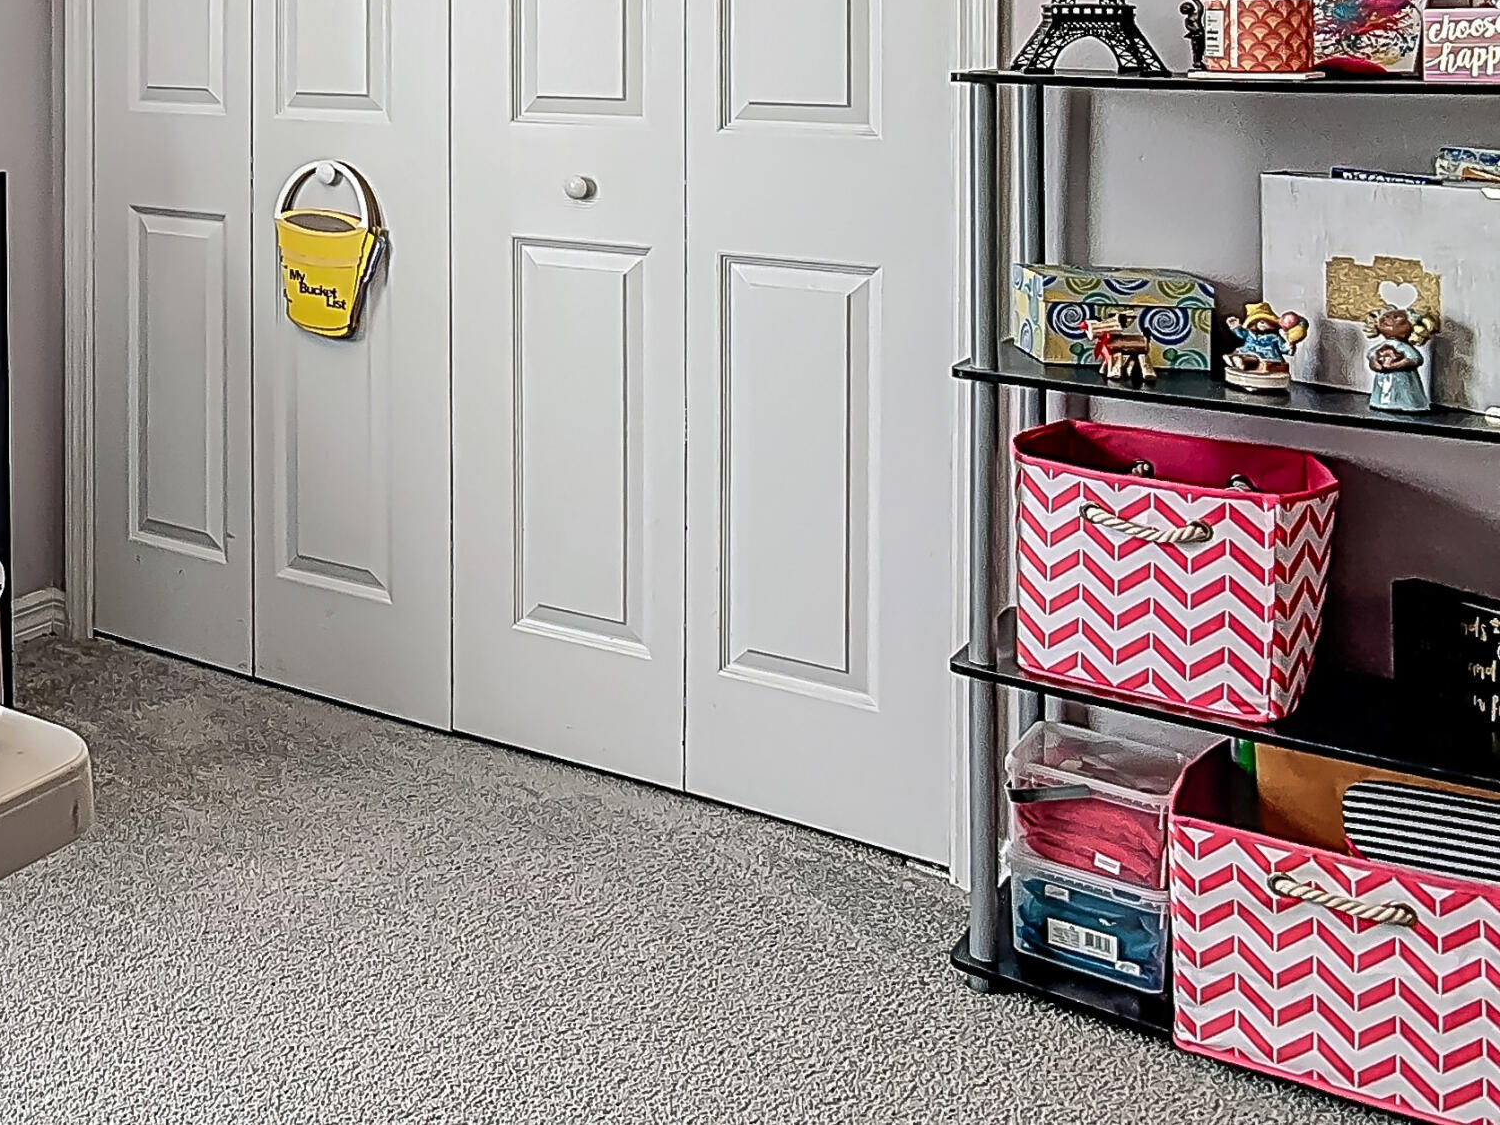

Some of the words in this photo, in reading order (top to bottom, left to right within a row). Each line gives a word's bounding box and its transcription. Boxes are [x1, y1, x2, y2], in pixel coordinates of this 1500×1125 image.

[289, 269, 305, 283] My
[299, 281, 337, 299] Bucket
[326, 296, 346, 310] List
